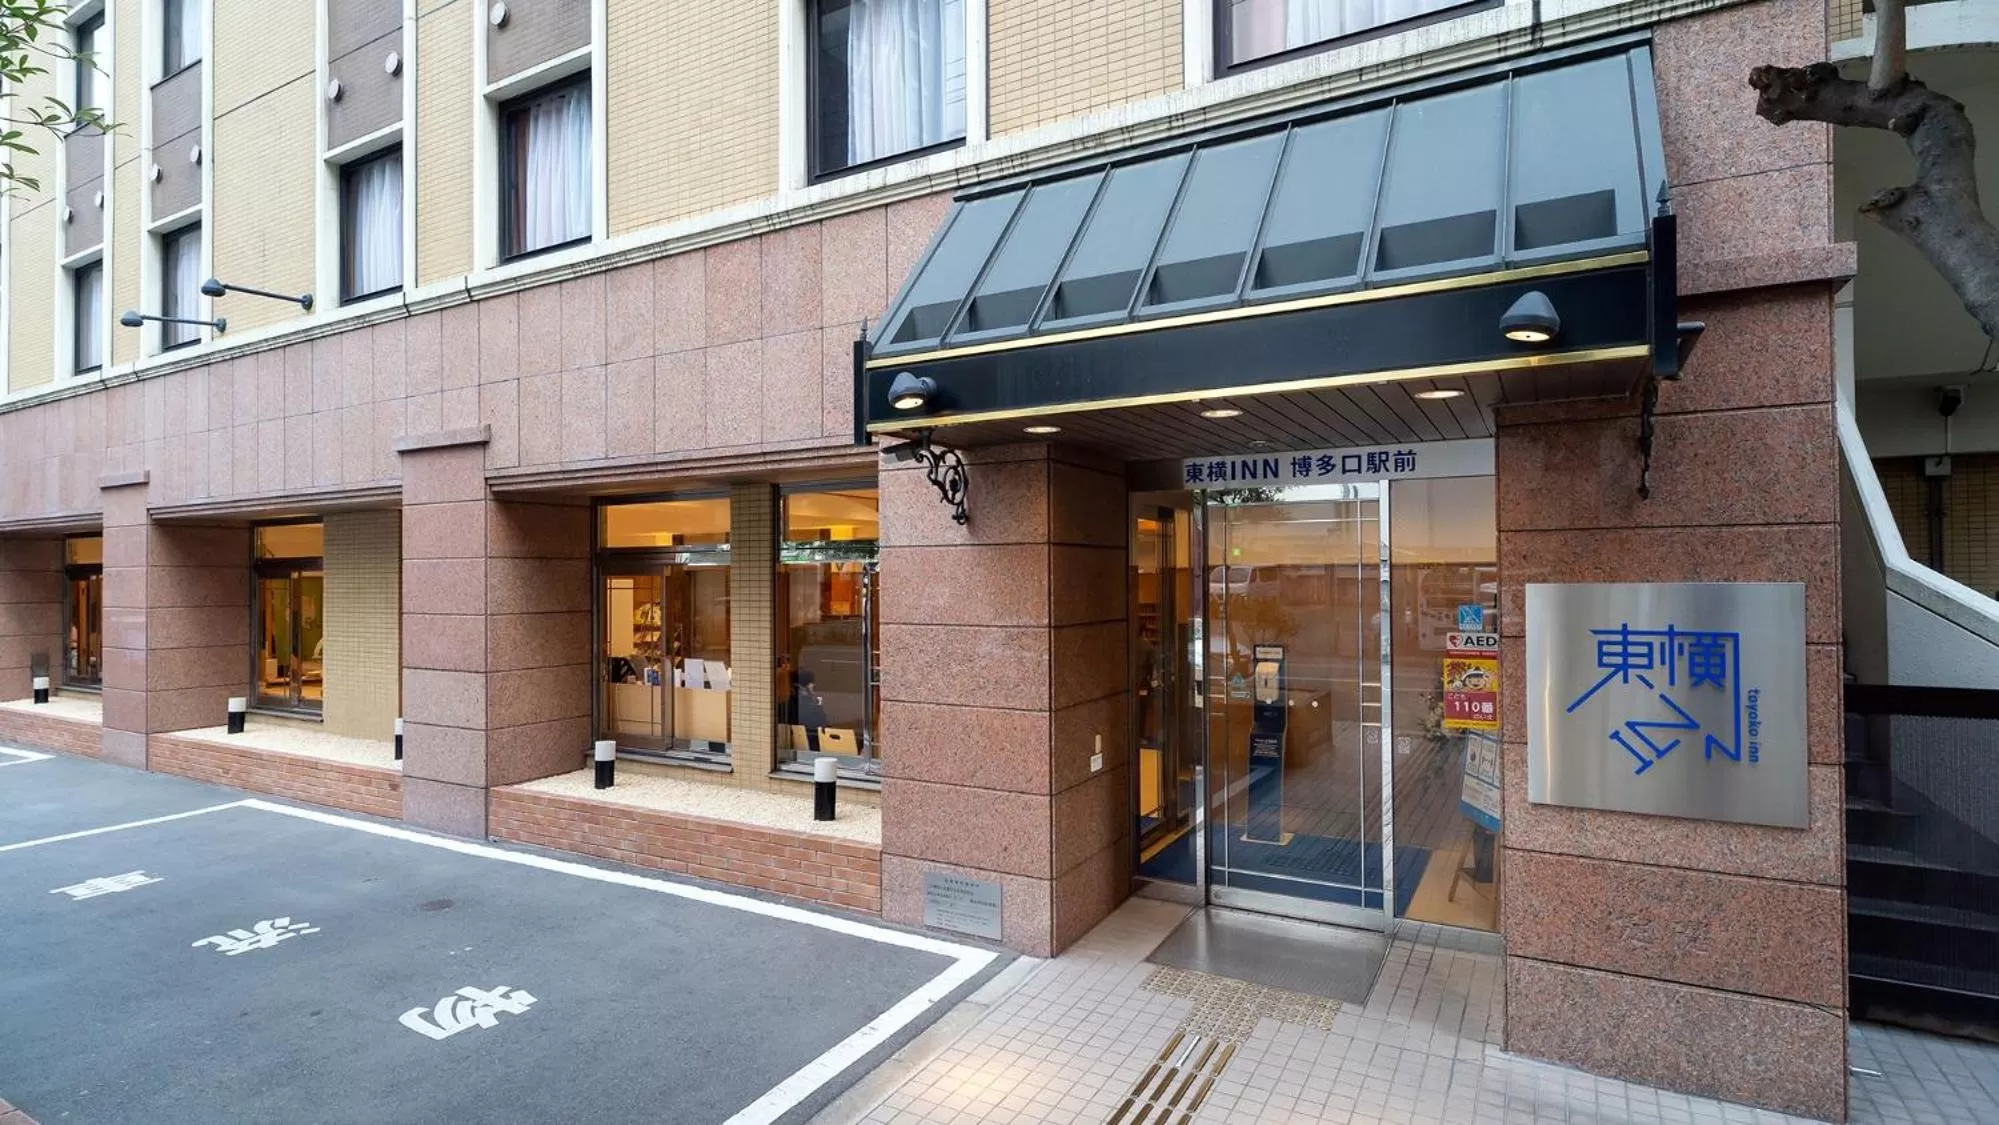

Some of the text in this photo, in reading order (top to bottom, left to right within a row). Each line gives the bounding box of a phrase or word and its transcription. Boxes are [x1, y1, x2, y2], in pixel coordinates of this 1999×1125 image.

[1185, 449, 1418, 483] 東横INN 博多口駅前
[1464, 636, 1497, 647] AED
[1745, 688, 1761, 763] toyoko inn
